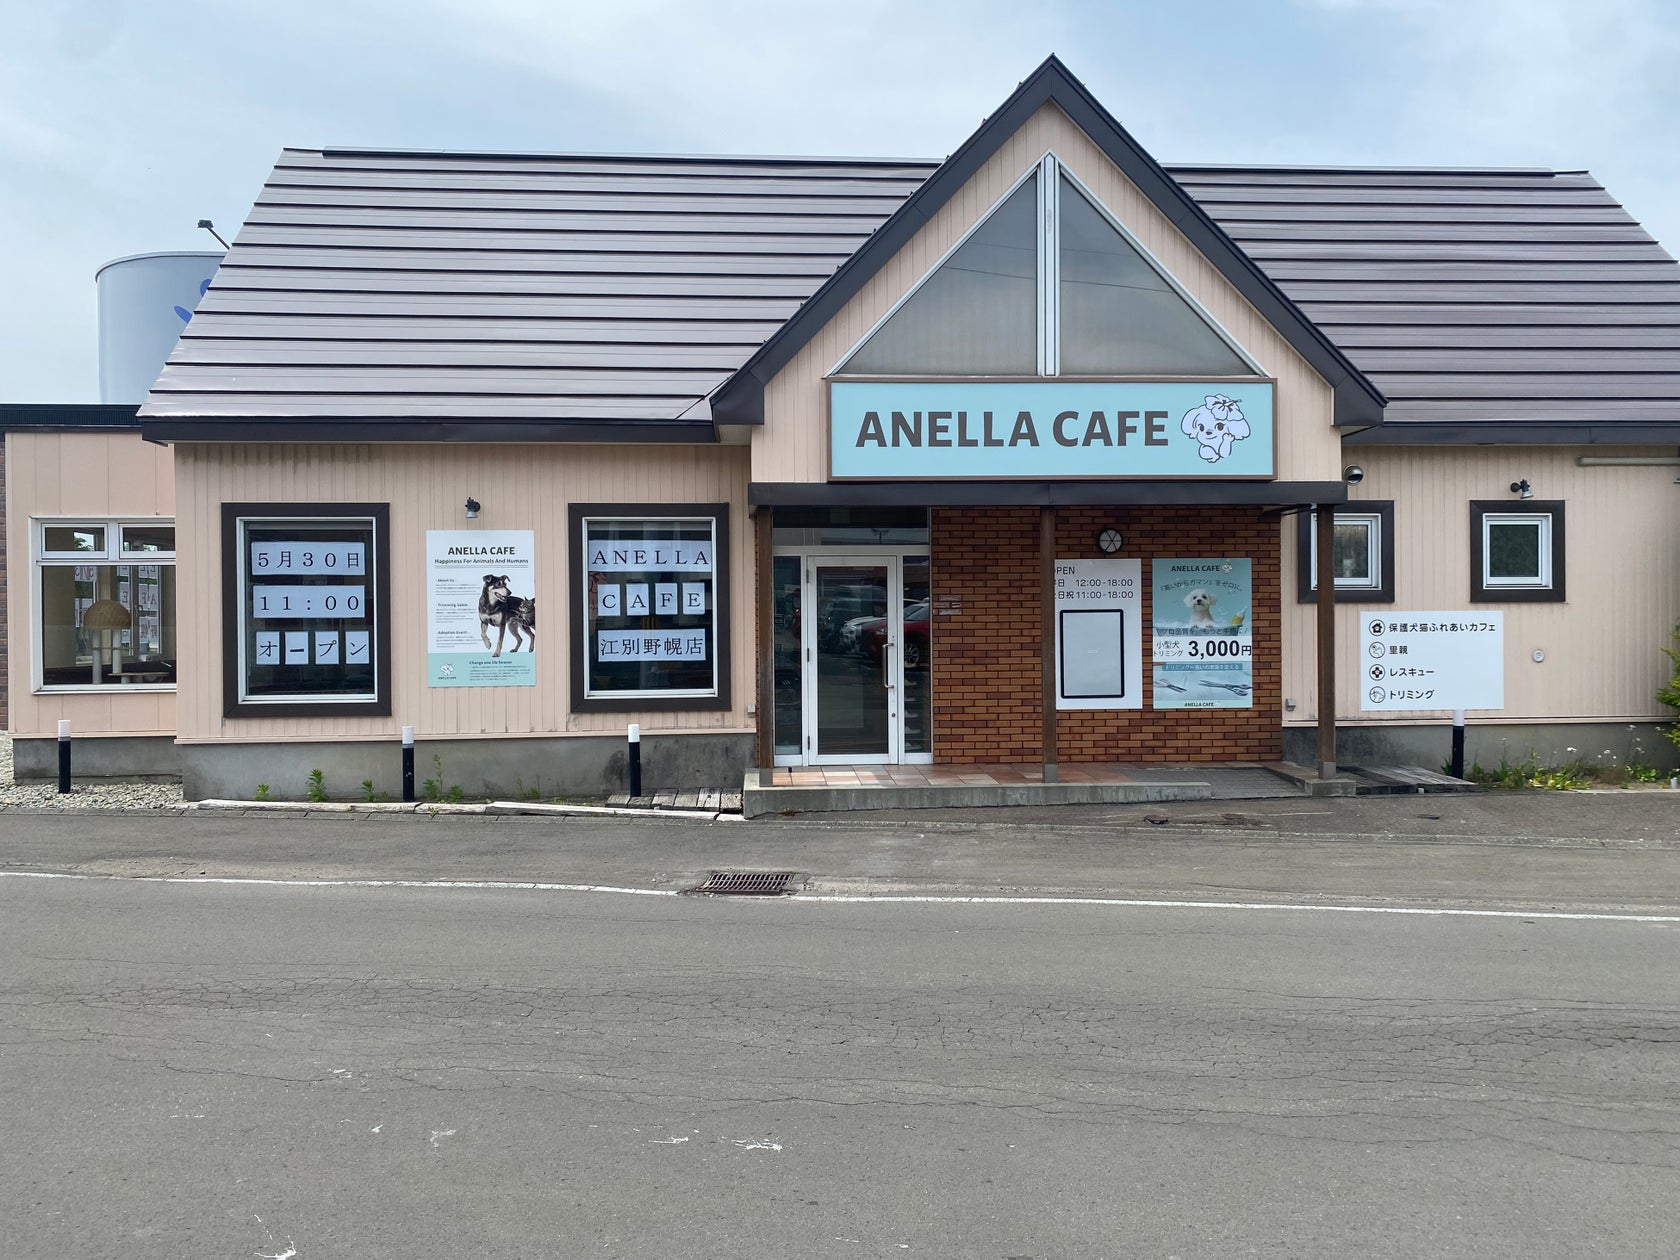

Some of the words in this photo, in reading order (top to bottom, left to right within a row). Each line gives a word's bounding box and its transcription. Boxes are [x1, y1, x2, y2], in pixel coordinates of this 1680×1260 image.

[855, 411, 1040, 447] ANELLA
[1052, 410, 1169, 447] CAFE
[448, 546, 488, 555] ANELLA
[490, 546, 516, 555] CAFE
[257, 550, 360, 568] 5月30日
[592, 550, 709, 565] ANELLA
[1075, 578, 1133, 587] 12:00-18:00
[602, 592, 702, 609] CAFE
[1076, 590, 1134, 599] 11:00-18:00
[260, 595, 359, 610] 11:00
[1388, 623, 1496, 632] 保護犬猫ふれあいカフェ
[259, 639, 367, 657] オープン
[600, 636, 703, 656] 江別野幌店
[1156, 641, 1180, 650] 小型犬
[1188, 640, 1252, 660] 3,000円
[1389, 645, 1408, 655] 里親
[1389, 667, 1435, 677] レスキュー
[1390, 689, 1436, 699] トリミング
